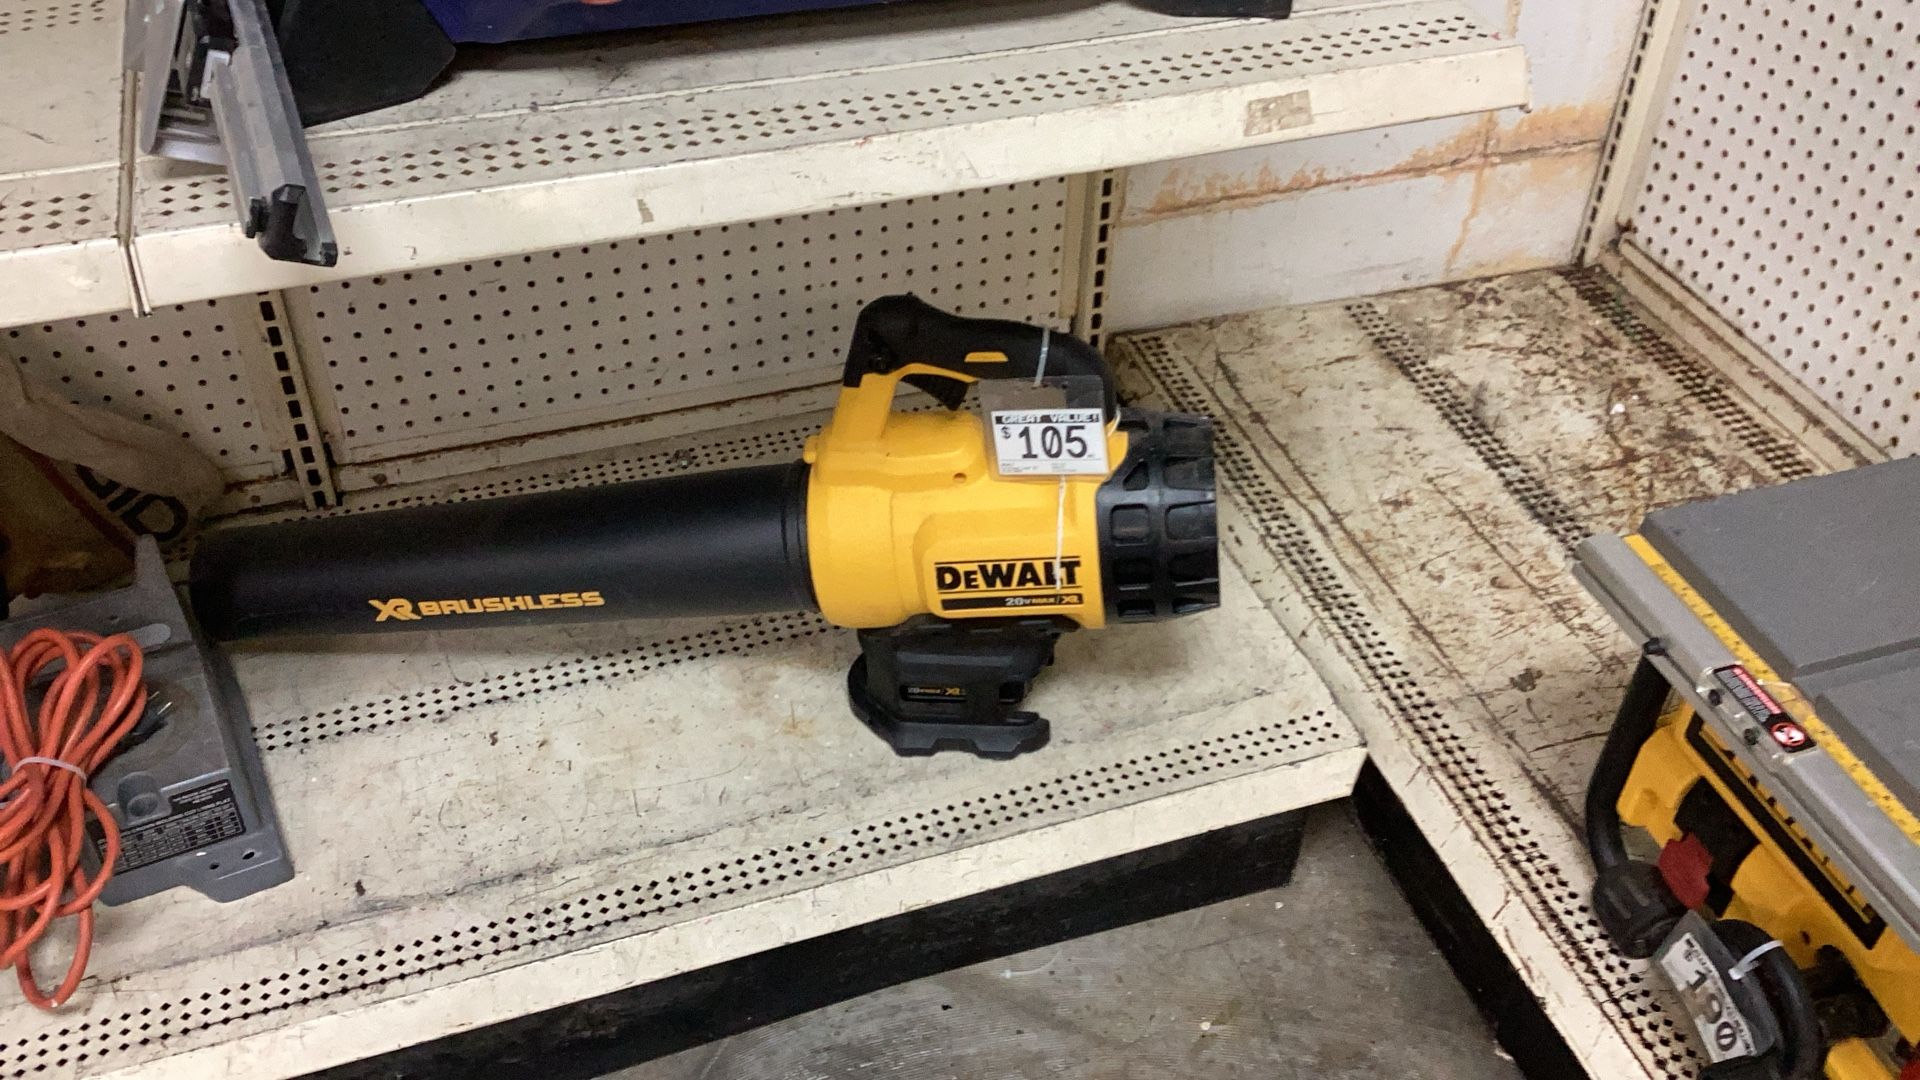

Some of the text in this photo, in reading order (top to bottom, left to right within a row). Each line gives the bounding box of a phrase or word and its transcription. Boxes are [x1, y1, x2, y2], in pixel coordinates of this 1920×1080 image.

[1001, 414, 1041, 424] GREAT
[1001, 425, 1087, 459] $ 105
[368, 591, 605, 621] XR BRUSHLESS
